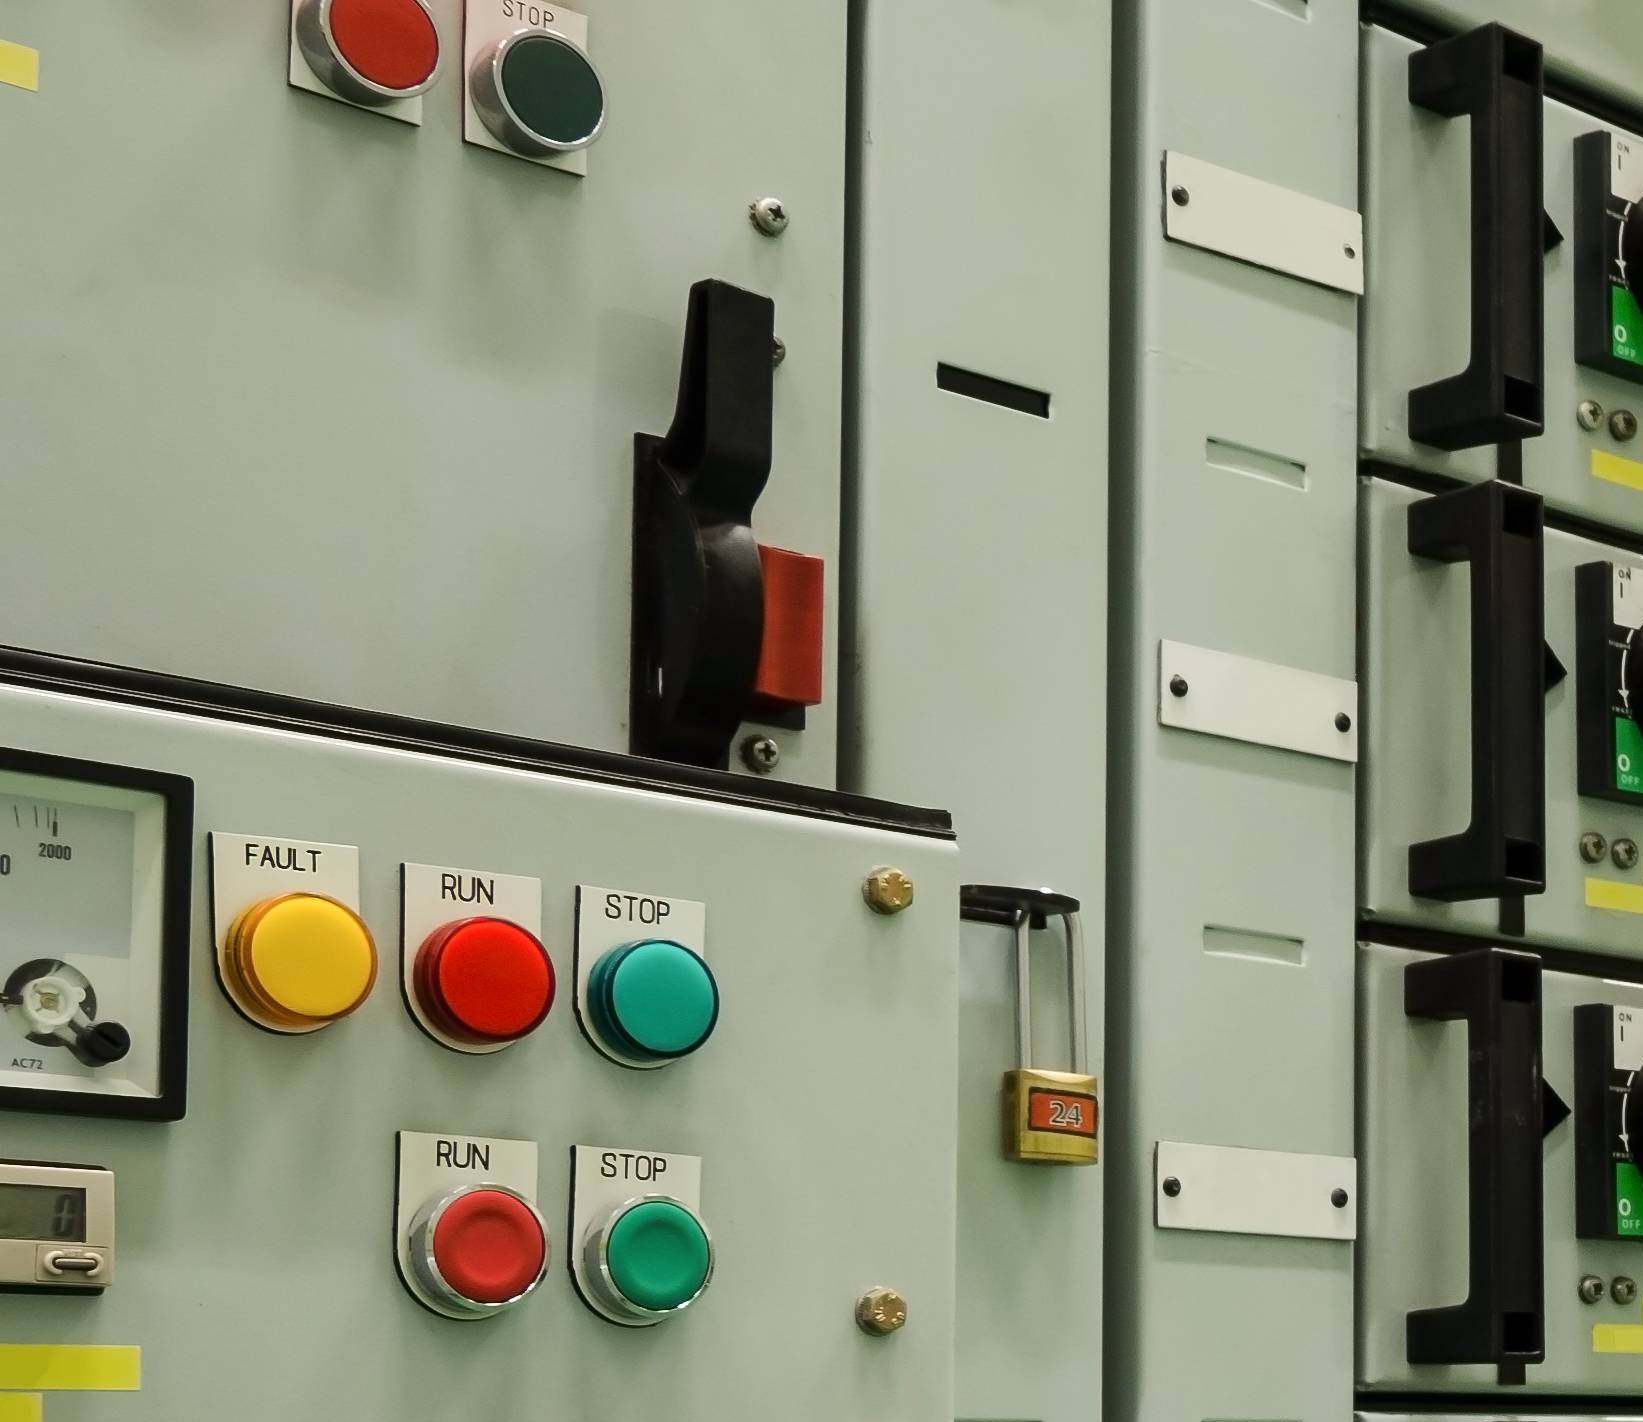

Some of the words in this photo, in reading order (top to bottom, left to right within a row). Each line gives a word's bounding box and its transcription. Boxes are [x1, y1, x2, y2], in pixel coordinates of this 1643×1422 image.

[502, 0, 555, 29] STOP
[38, 842, 72, 861] 2000
[245, 844, 322, 873] FAULT
[441, 873, 495, 905] RUN
[605, 894, 671, 925] STOP
[1049, 1099, 1084, 1128] 24
[436, 1140, 491, 1171] RUN
[601, 1152, 667, 1182] STOP
